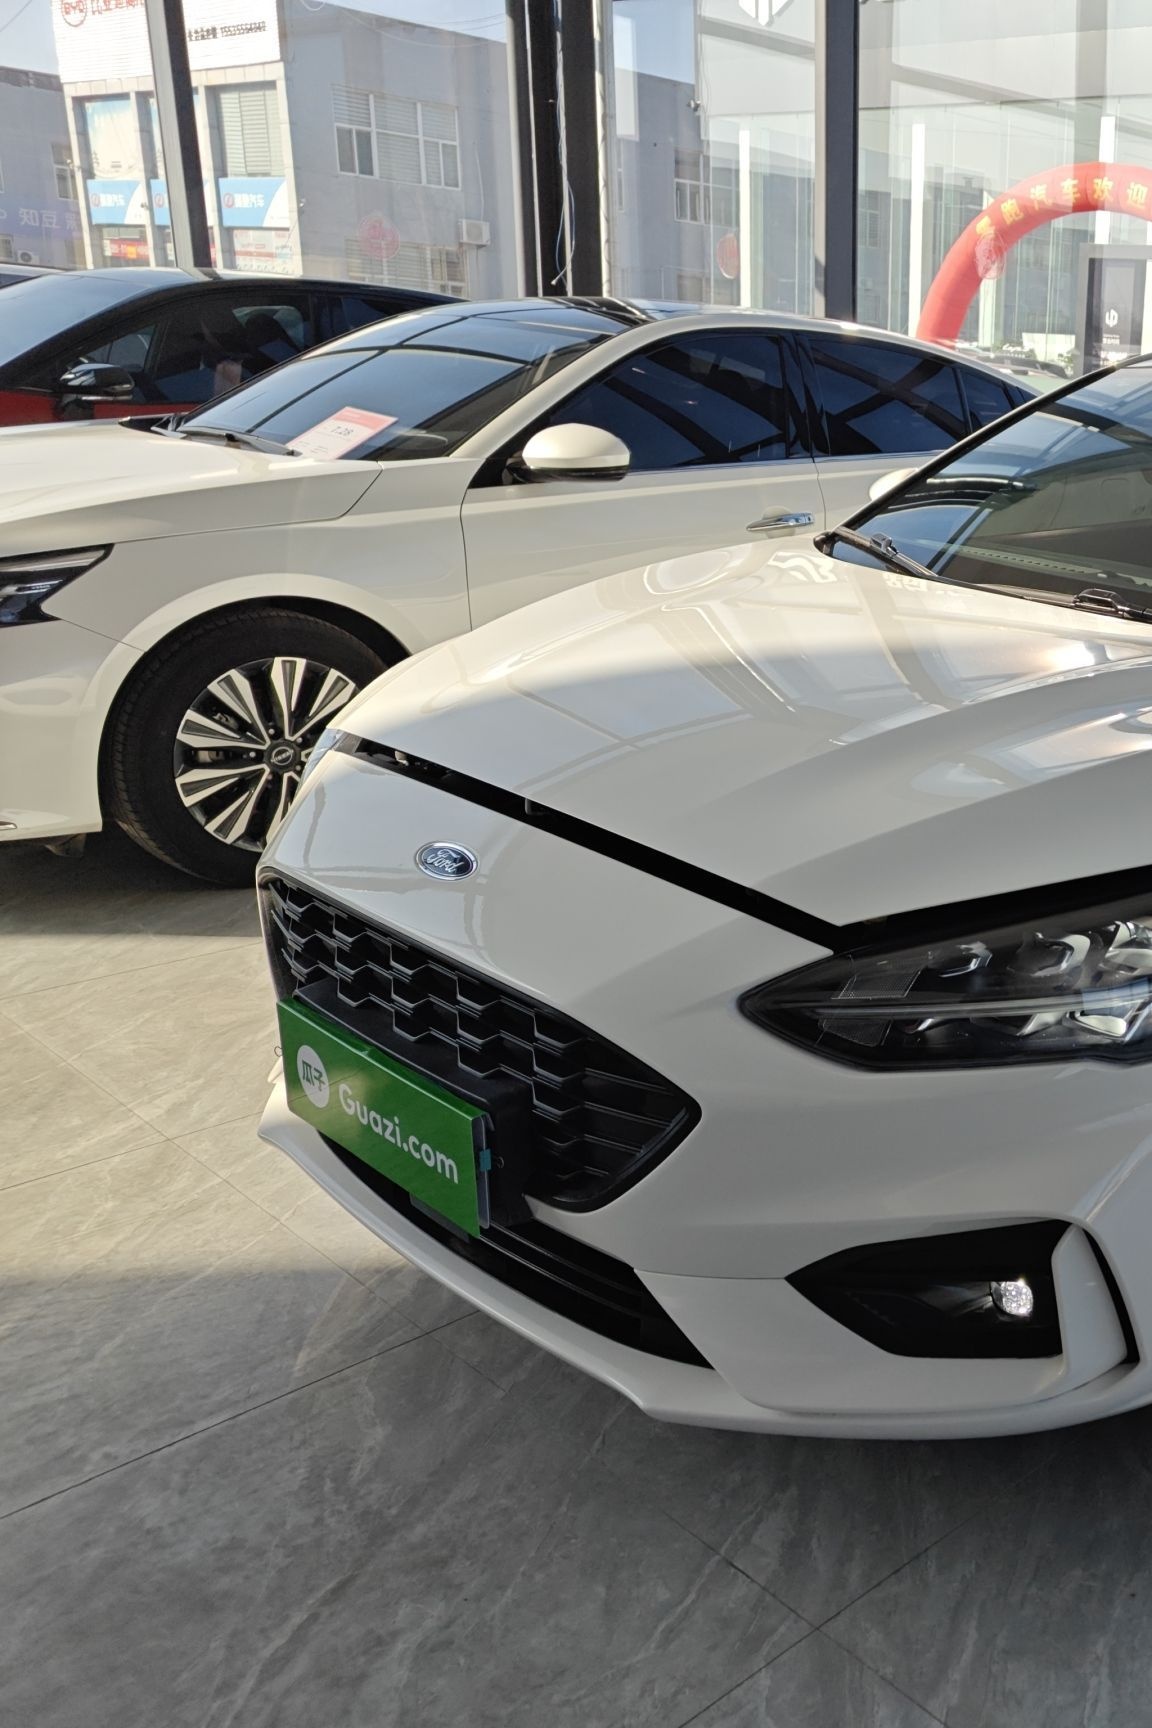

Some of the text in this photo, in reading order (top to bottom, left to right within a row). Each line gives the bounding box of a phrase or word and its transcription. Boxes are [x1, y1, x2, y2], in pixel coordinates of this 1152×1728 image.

[426, 848, 464, 873] Ford
[302, 1059, 325, 1092] 瓜子
[338, 1083, 459, 1185] Guazi.com
